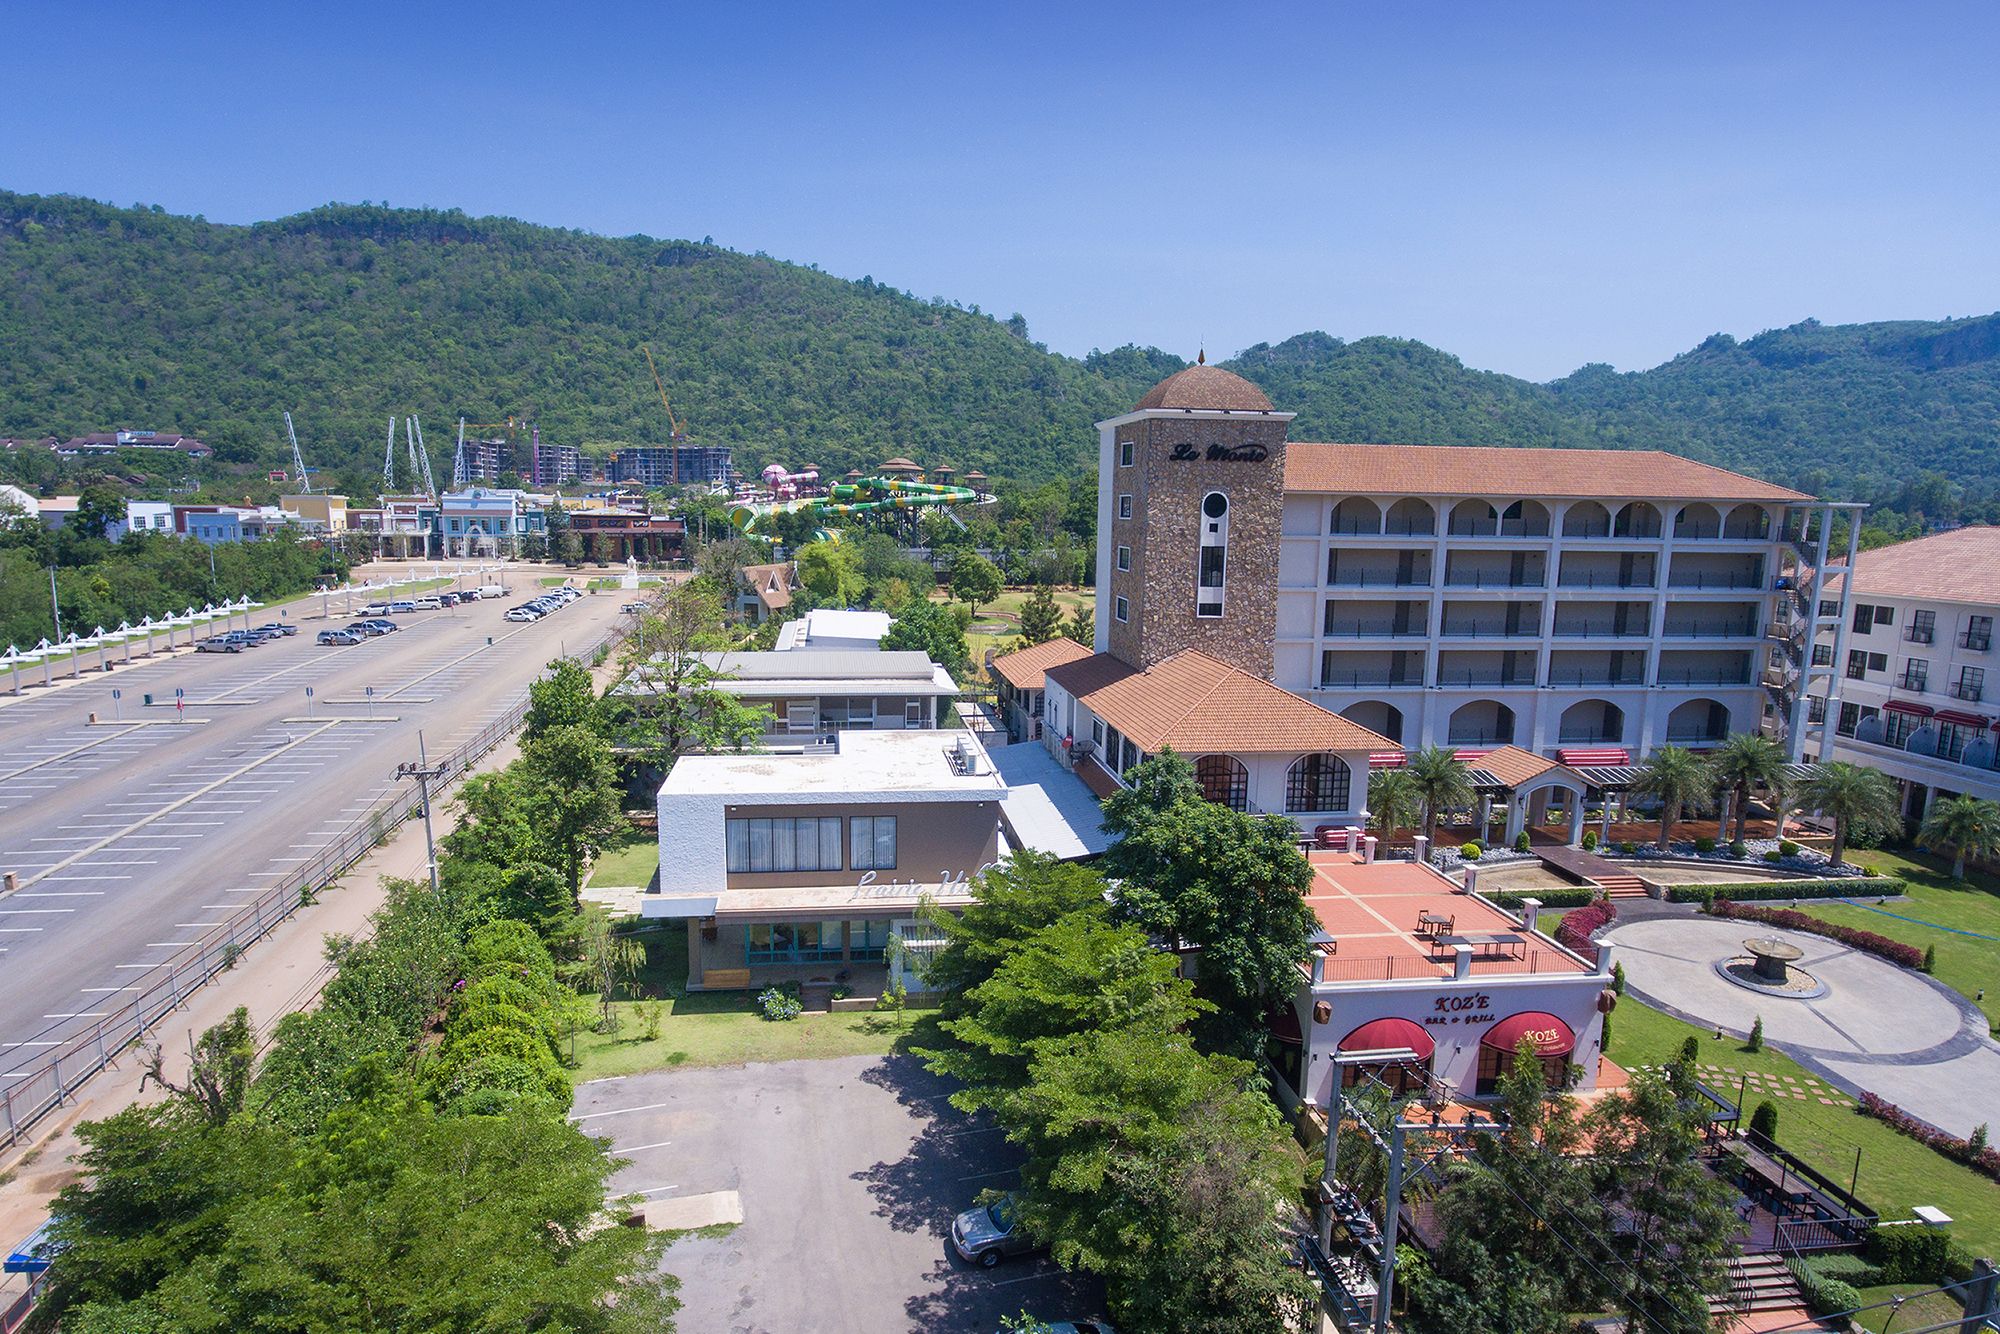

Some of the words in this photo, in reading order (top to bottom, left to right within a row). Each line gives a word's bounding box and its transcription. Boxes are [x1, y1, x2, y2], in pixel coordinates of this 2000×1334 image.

[1169, 444, 1201, 461] Le
[847, 870, 926, 903] Prairie
[935, 862, 1001, 897] Hi
[1465, 1013, 1495, 1025] GRILL
